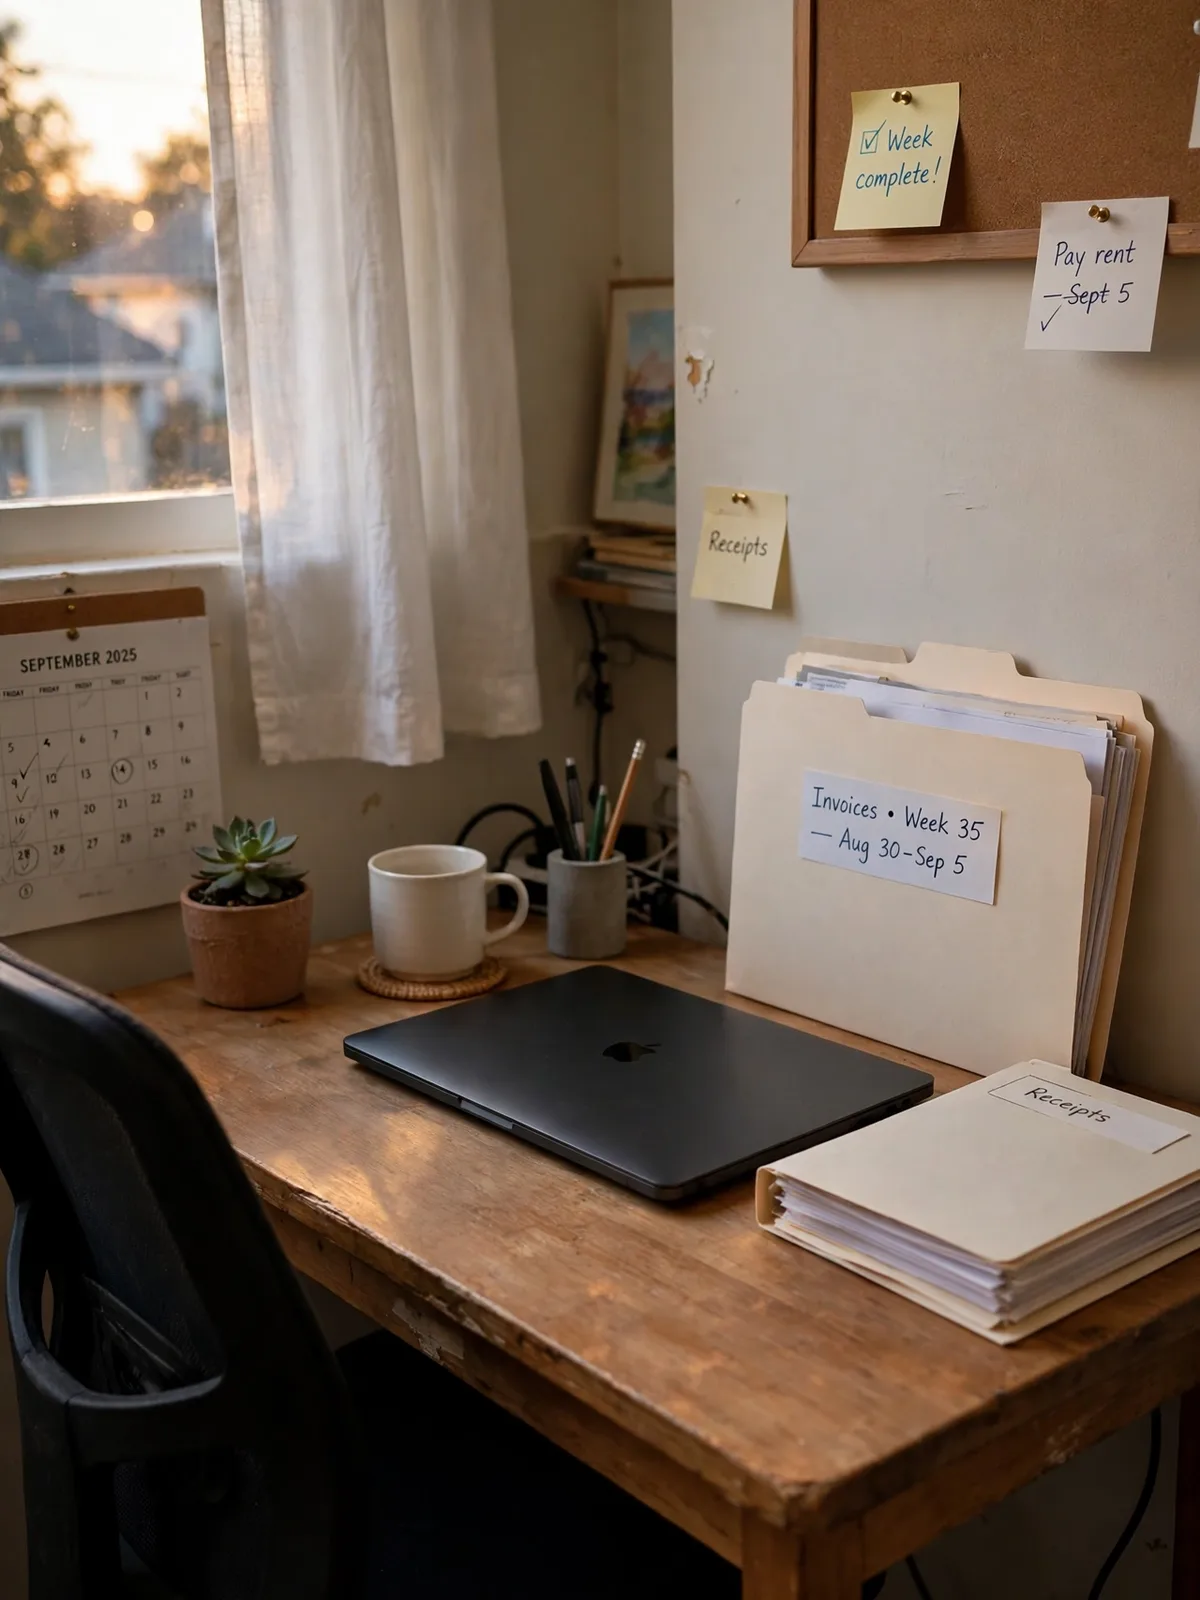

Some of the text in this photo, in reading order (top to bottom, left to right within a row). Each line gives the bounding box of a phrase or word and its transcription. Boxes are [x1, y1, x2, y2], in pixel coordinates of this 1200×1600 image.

[888, 124, 933, 151] Week
[856, 156, 942, 197] complete!
[1054, 239, 1136, 277] Pay rent
[1118, 281, 1134, 303] 5
[709, 530, 768, 563] Receipts
[20, 648, 138, 673] SEPTEMBER 2025
[176, 687, 182, 698] 2
[43, 738, 51, 747] 4
[79, 734, 86, 744] 6
[113, 729, 119, 739] 7
[81, 769, 92, 779] 13
[148, 760, 158, 770] 15
[15, 815, 25, 825] 16
[84, 804, 96, 814] 20
[117, 799, 128, 809] 21
[151, 794, 162, 804] 22
[811, 786, 877, 819] Invoices
[905, 805, 949, 835] Week
[957, 818, 984, 840] 35
[87, 838, 98, 849] 27
[838, 827, 869, 864] Aug
[953, 855, 967, 875] 5
[1024, 1087, 1111, 1123] Receipts
